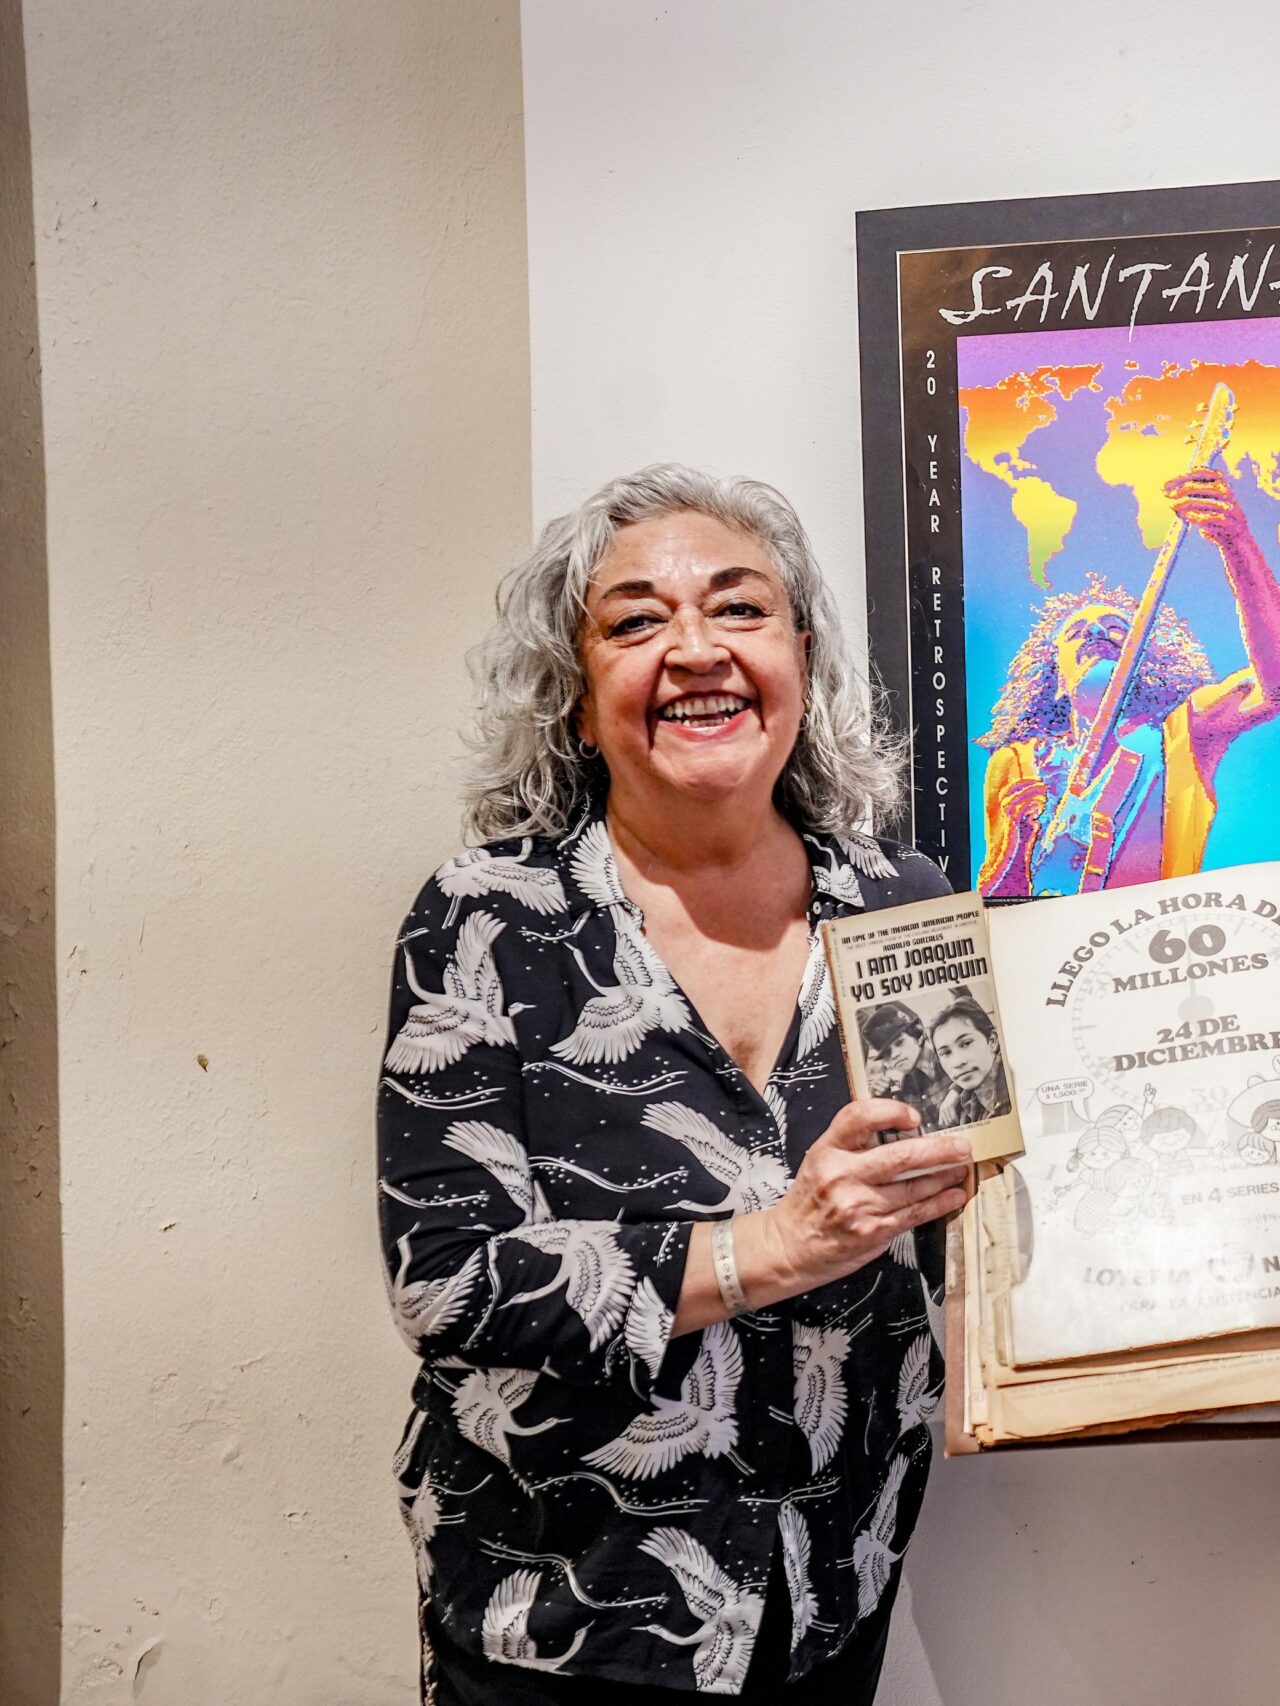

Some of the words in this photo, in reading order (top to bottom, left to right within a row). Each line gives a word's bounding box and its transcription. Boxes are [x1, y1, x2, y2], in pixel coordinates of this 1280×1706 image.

[926, 349, 937, 396] 20
[927, 434, 941, 533] YEAR
[931, 566, 950, 873] RETROSPECTIV
[878, 929, 889, 938] THE
[891, 922, 920, 935] MEXICAN
[921, 915, 955, 929] AMERICAN
[955, 910, 980, 922] PEOPLE
[1148, 924, 1227, 964] 60
[855, 961, 863, 979] I
[867, 954, 898, 977] AM
[904, 937, 975, 969] JOAQUIN
[1046, 931, 1111, 1008] LLEGO
[1110, 908, 1155, 935] LA
[1157, 892, 1248, 916] HORA
[850, 982, 875, 1002] YO
[880, 973, 913, 996] SOY
[918, 957, 988, 988] JOAQUIN
[1112, 952, 1270, 994] MILLONES
[1156, 1021, 1193, 1044] 24
[1197, 1014, 1240, 1037] DE
[1041, 1085, 1060, 1093] UNA
[1063, 1080, 1089, 1090] SERIE
[1182, 1193, 1202, 1206] EN
[1207, 1187, 1223, 1203] 4
[1226, 1182, 1280, 1198] SERIES
